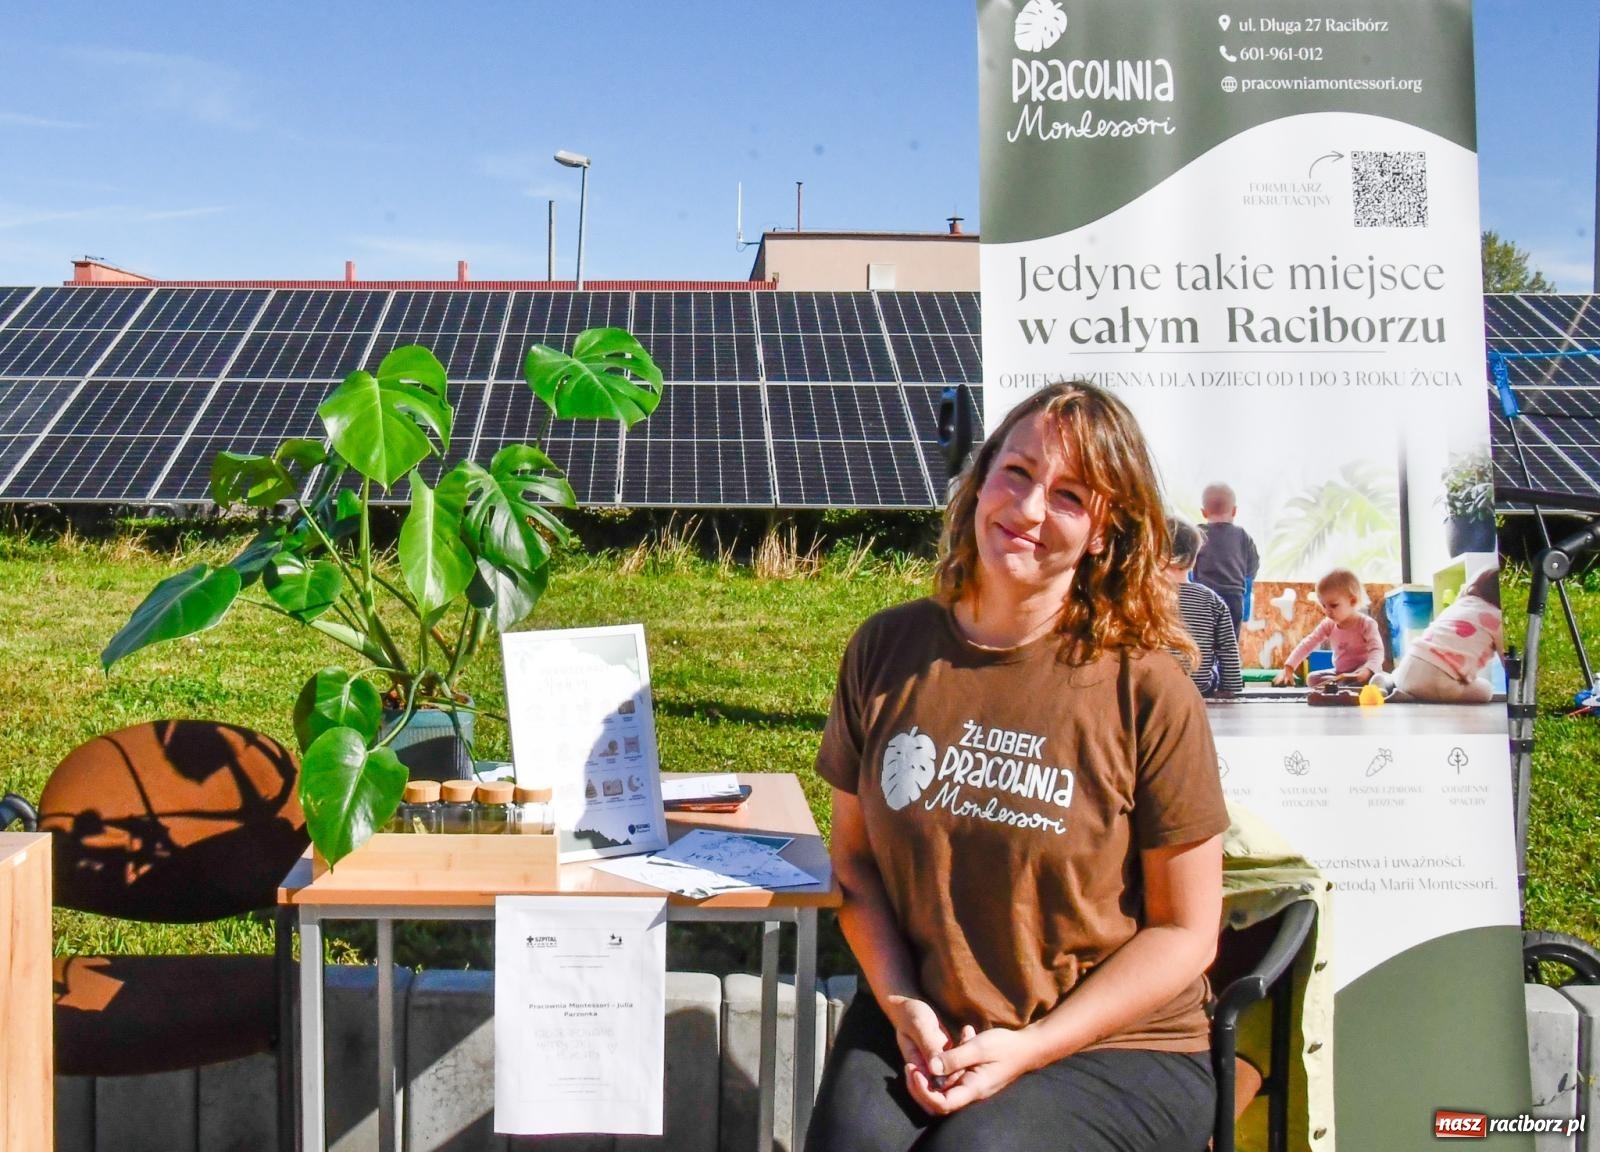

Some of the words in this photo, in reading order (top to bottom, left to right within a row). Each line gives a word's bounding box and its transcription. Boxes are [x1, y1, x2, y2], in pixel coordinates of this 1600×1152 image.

[1239, 18, 1256, 32] ul.
[1259, 17, 1301, 36] Długa
[1303, 18, 1321, 32] 27
[1325, 17, 1389, 32] Racibórz
[1240, 47, 1323, 61] 601-961-012
[1241, 76, 1422, 94] pracowniamontessori.org
[1007, 104, 1176, 143] Montessori
[1248, 182, 1323, 194] FORMULARZ
[1242, 195, 1332, 207] REKRUTACYJNY
[1018, 254, 1161, 301] Jedyne
[1175, 253, 1275, 292] takie
[1289, 254, 1445, 299] miejsce
[1018, 318, 1057, 344] w
[1069, 306, 1199, 353] całym
[1226, 305, 1447, 344] Raciborzu
[1160, 372, 1196, 387] DLA
[1201, 371, 1261, 387] DZIECI
[1266, 371, 1293, 386] OD
[1310, 371, 1337, 386] DO
[1343, 371, 1351, 386] 3
[1356, 371, 1404, 386] ROKU
[1410, 368, 1463, 386] ŻYCIA
[958, 719, 1046, 760] ŻŁOBEK
[924, 781, 1066, 834] Montessori
[1380, 877, 1414, 890] Marii
